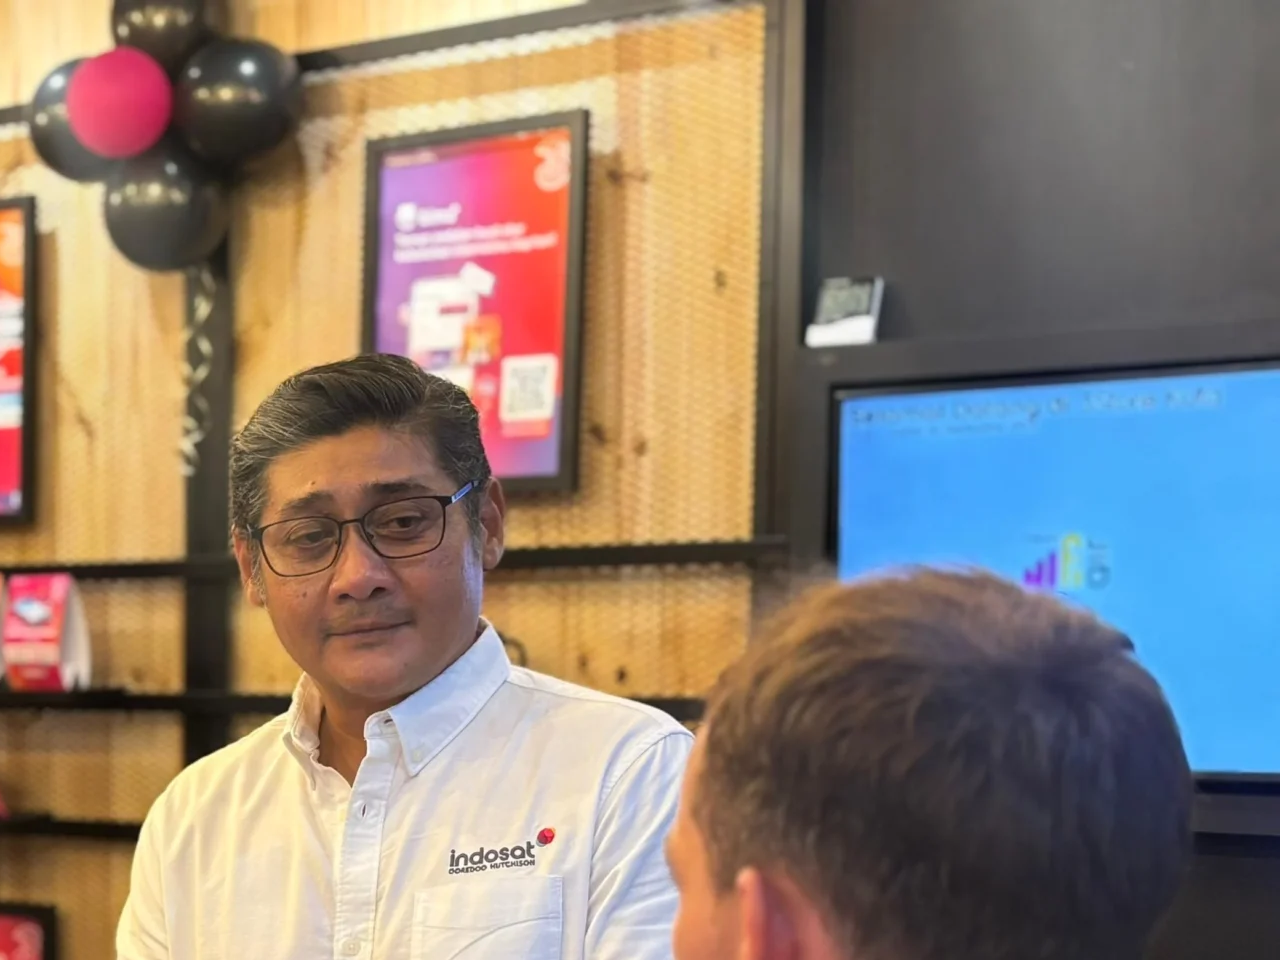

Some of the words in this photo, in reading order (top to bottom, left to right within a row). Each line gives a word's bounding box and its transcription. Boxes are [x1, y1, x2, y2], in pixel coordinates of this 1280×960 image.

[449, 841, 536, 868] indosat
[448, 864, 488, 875] OOREDOO
[489, 859, 536, 870] HUTCHISON
